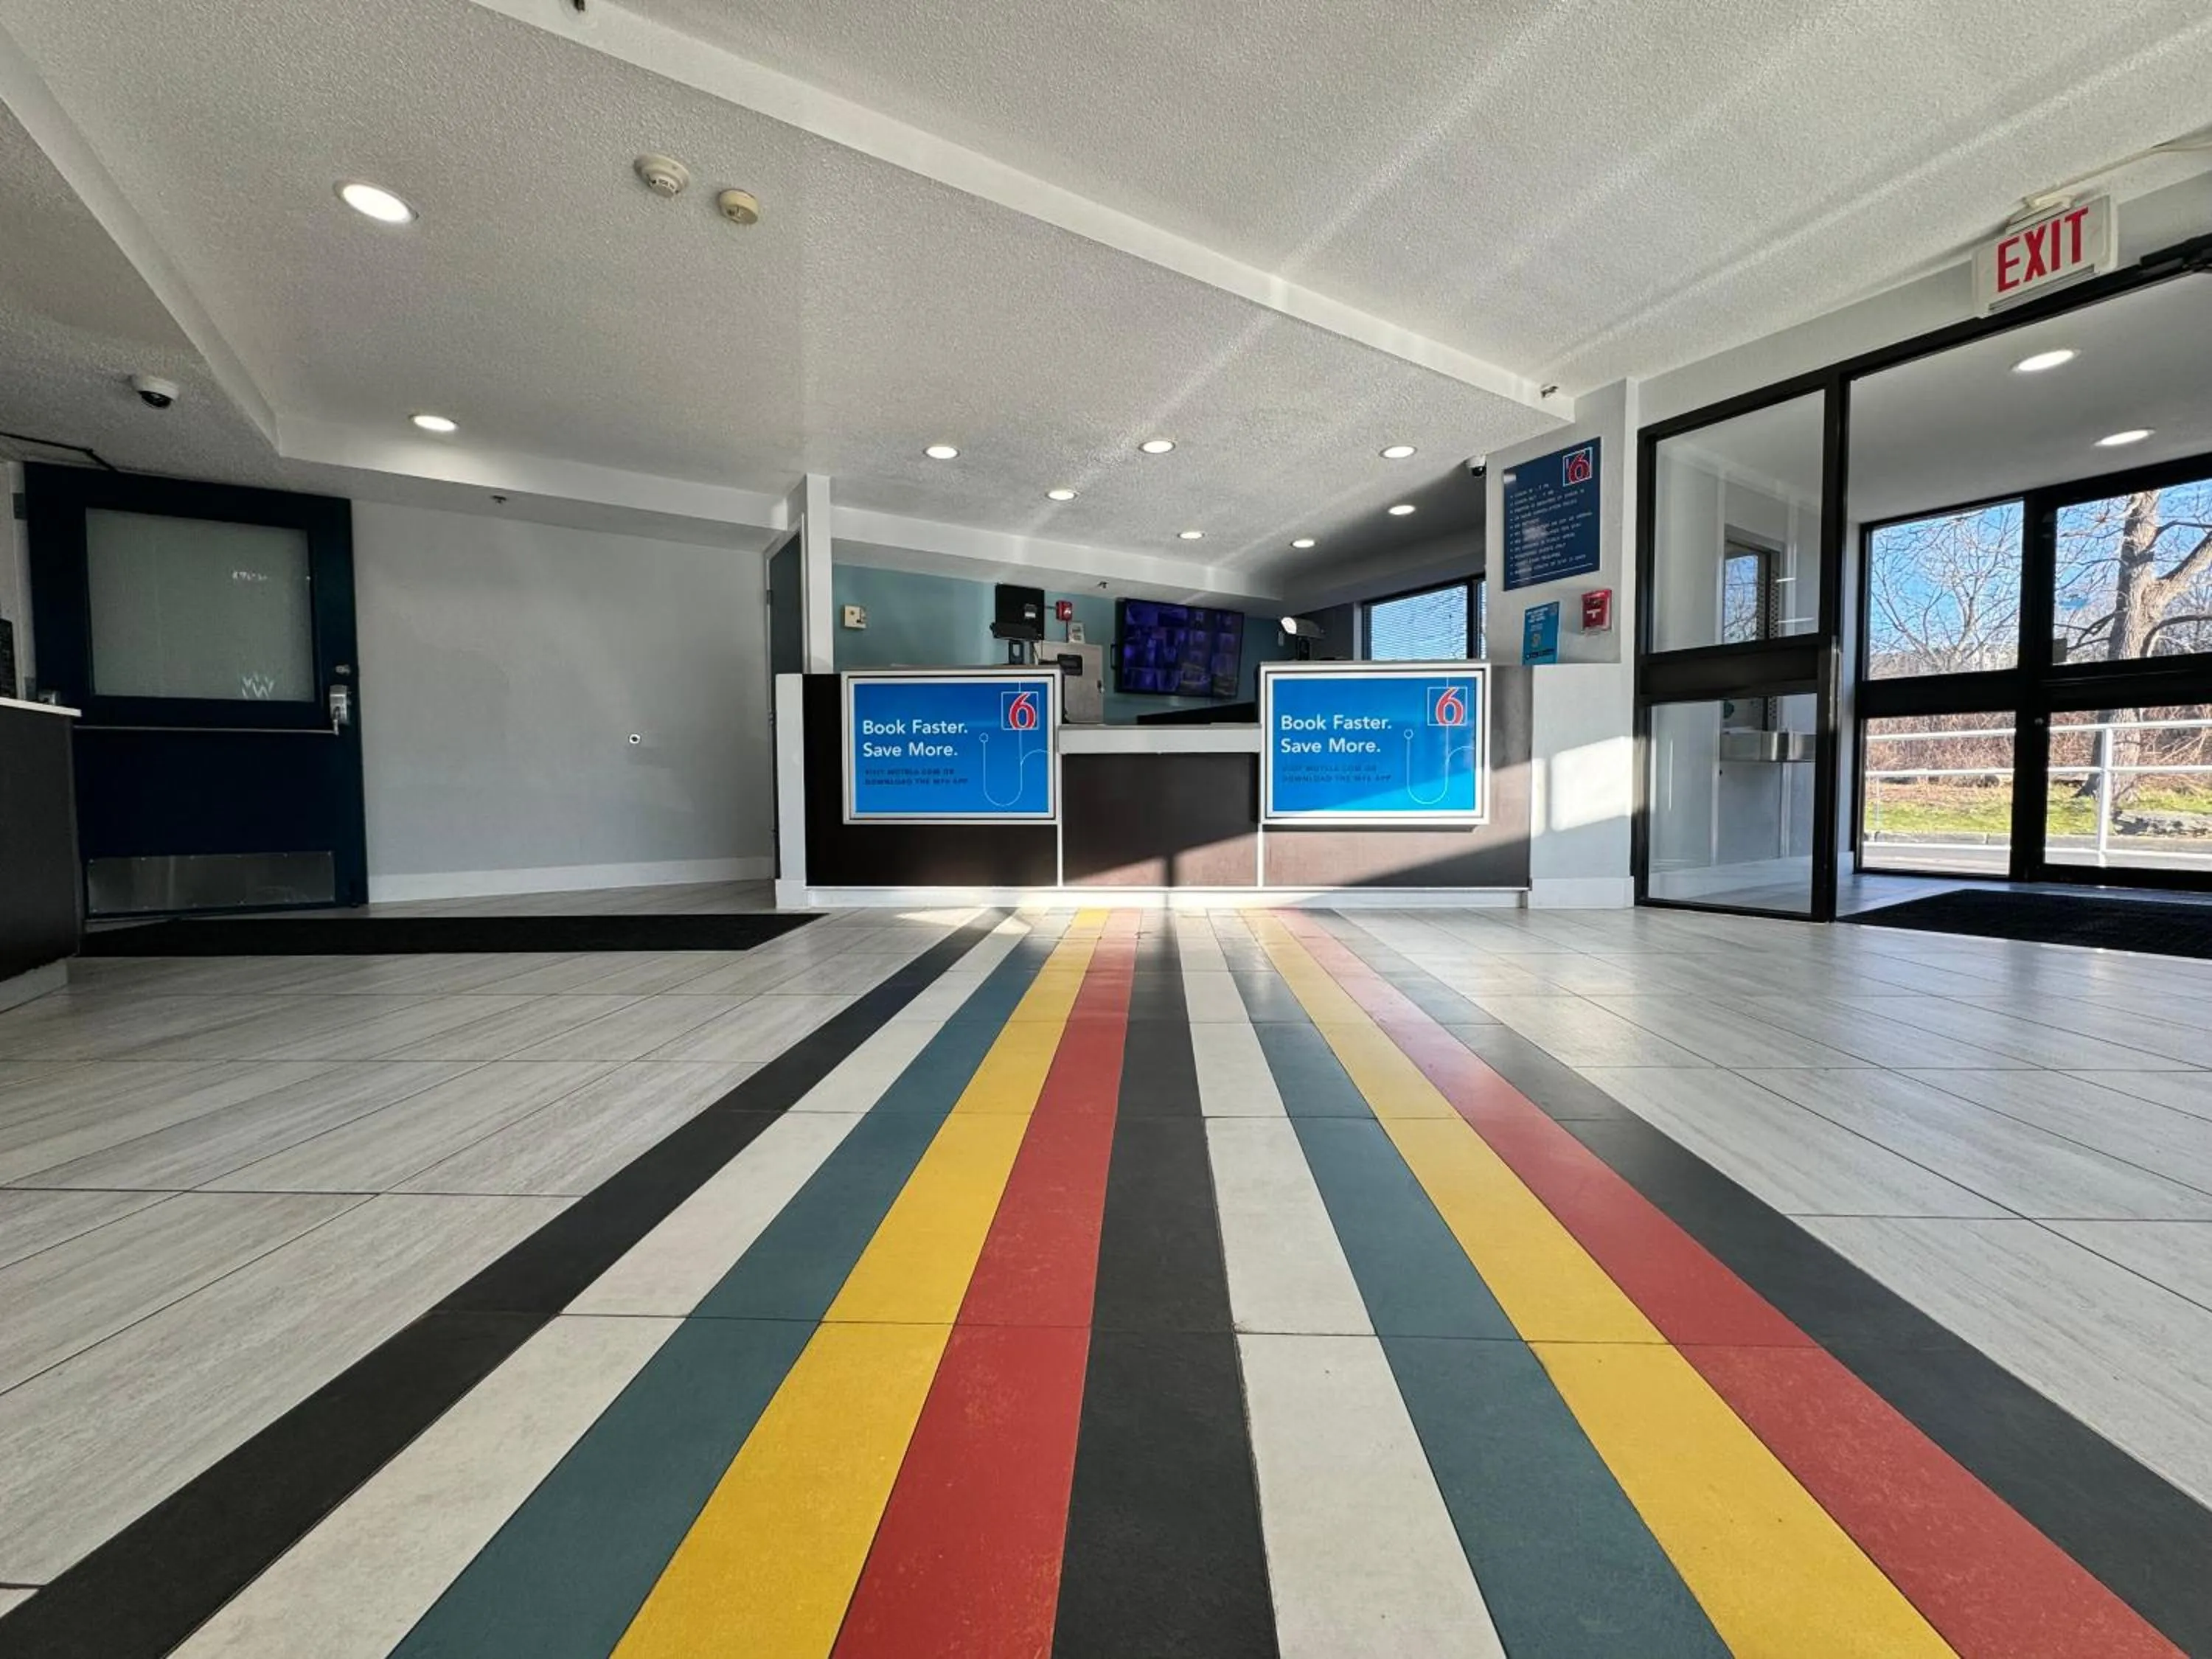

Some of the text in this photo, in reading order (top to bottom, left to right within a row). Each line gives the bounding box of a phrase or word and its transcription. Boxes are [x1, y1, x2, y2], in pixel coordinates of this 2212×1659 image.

[1997, 206, 2089, 293] EXIT
[1568, 451, 1591, 484] 6
[1008, 692, 1037, 730] 6
[1435, 686, 1464, 726] 6
[863, 719, 968, 735] Book Faster.
[1280, 714, 1392, 731] Book Faster.
[863, 742, 958, 757] Save More.
[1280, 738, 1381, 754] Save More.
